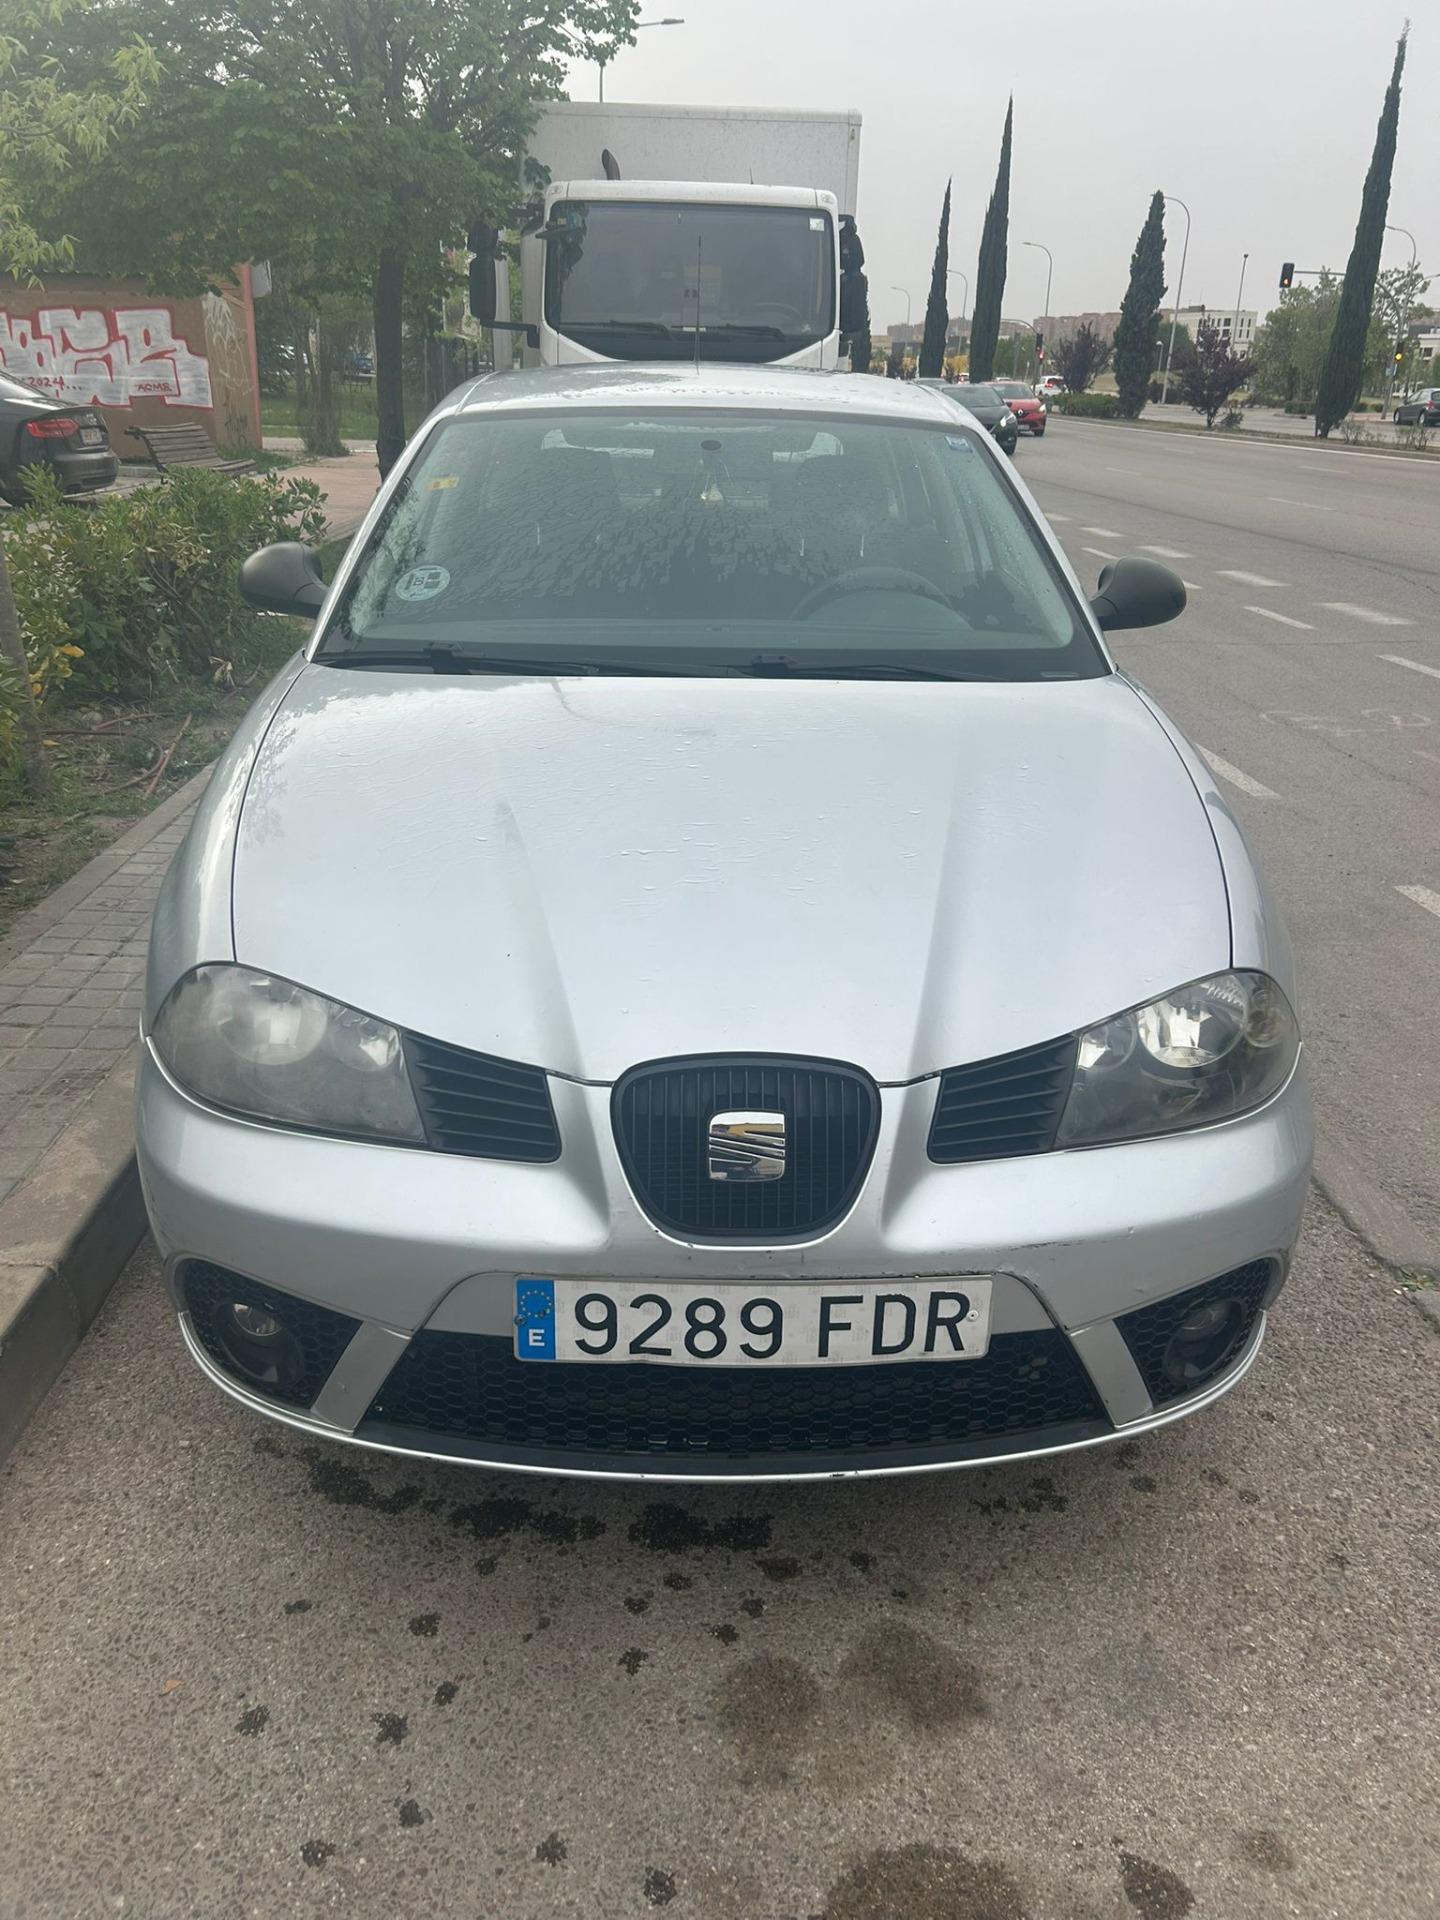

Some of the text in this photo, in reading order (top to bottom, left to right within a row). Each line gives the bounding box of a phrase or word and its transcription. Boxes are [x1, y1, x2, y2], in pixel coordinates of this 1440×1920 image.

[529, 1328, 545, 1346] E
[574, 1291, 971, 1359] 9289 FDR
